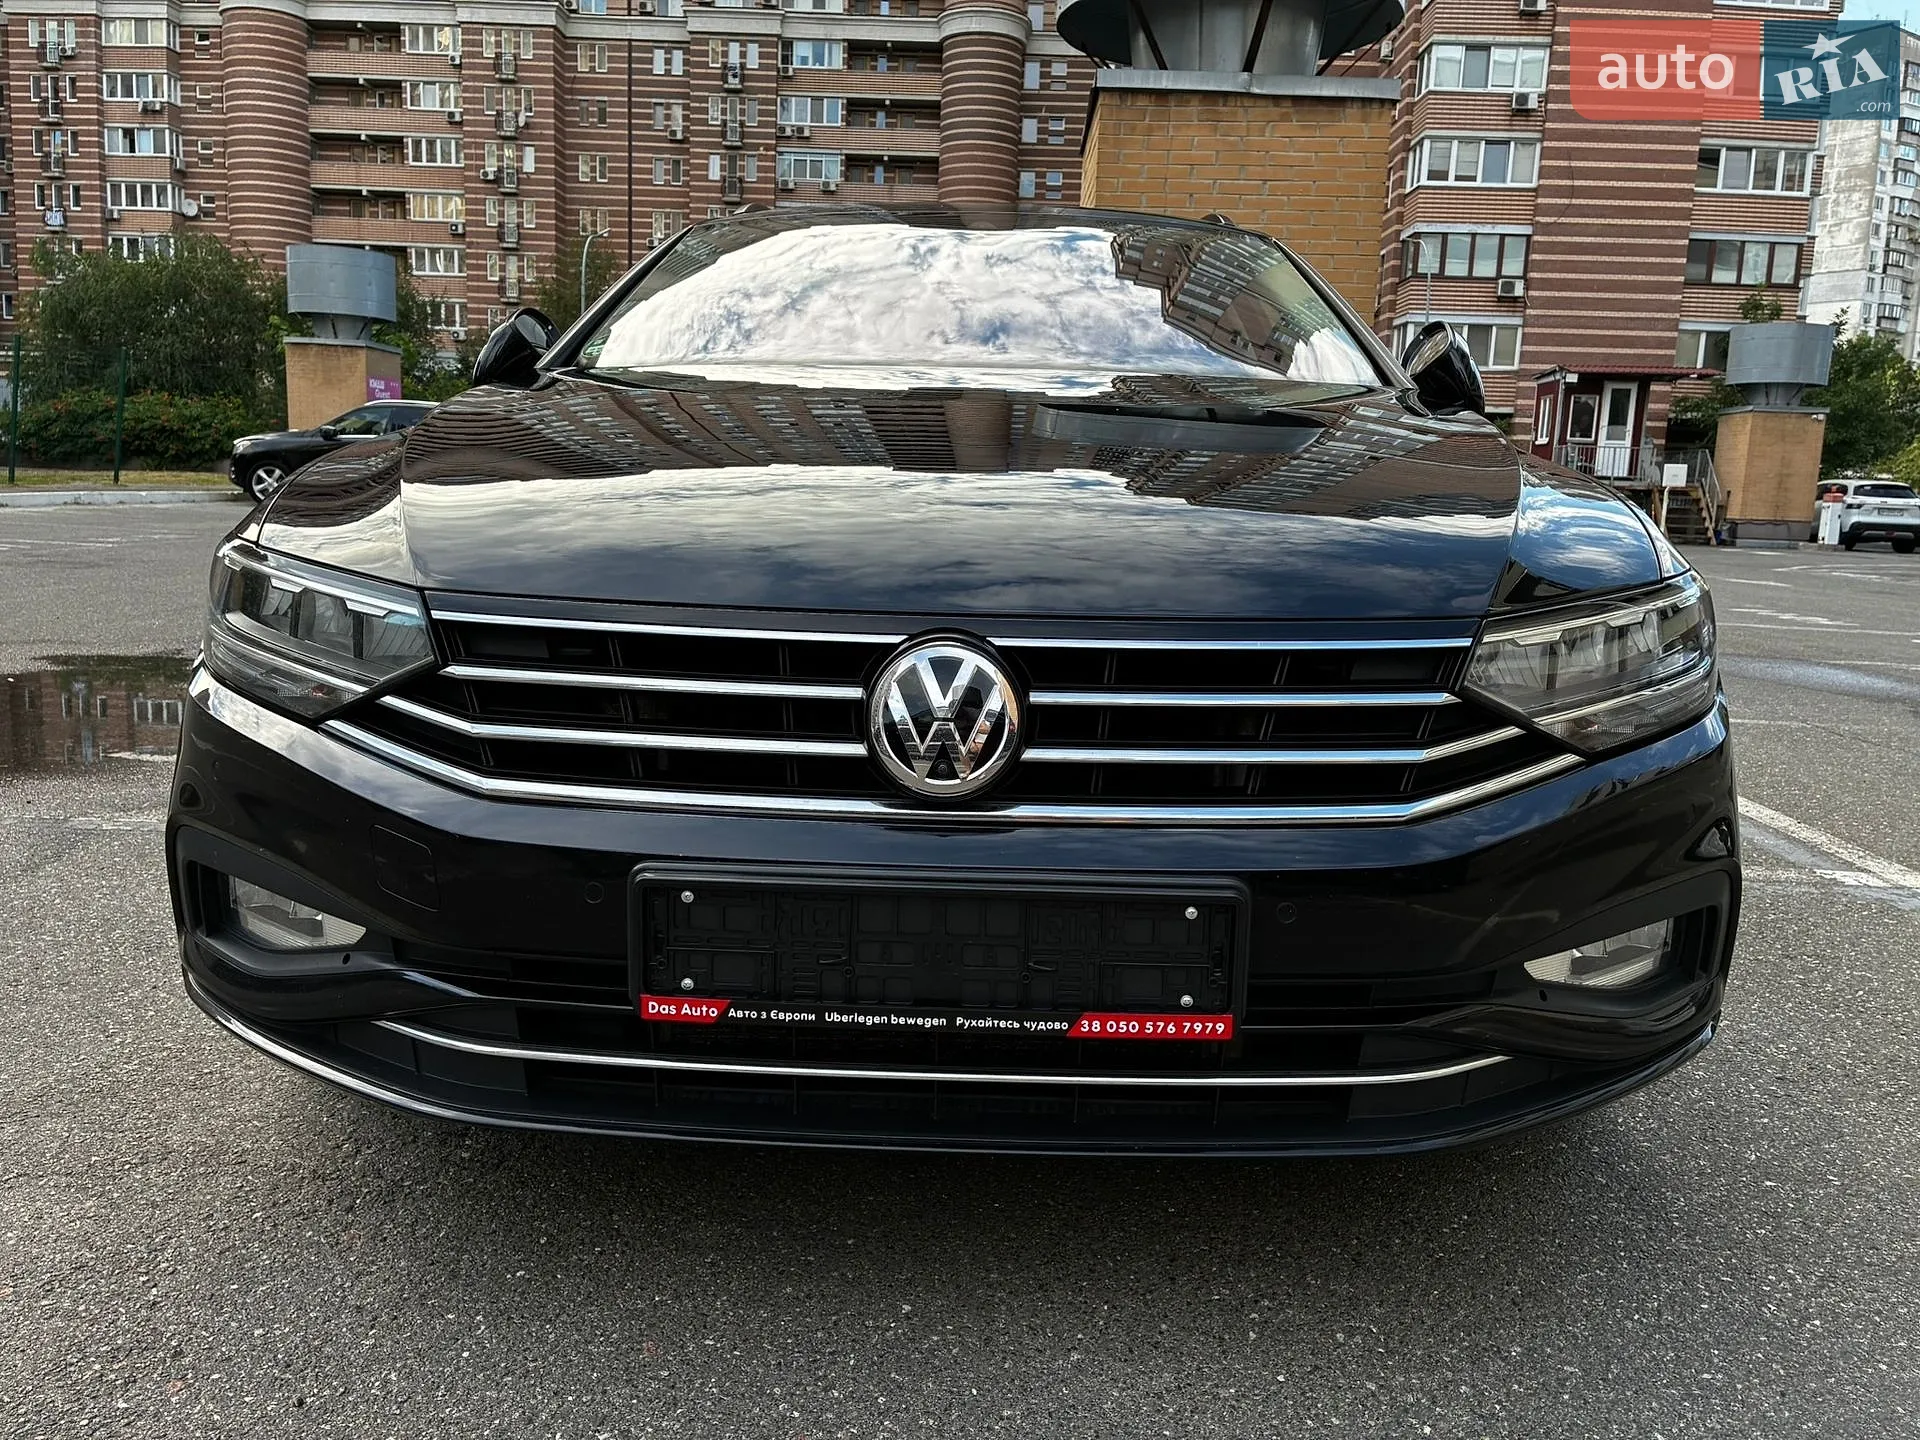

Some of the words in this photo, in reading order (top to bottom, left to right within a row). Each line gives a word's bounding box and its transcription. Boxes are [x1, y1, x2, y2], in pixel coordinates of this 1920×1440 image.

[648, 1001, 677, 1015] Das
[680, 1003, 718, 1017] Auto
[727, 1007, 758, 1019] Авто
[770, 1009, 816, 1023] Європи
[824, 1011, 888, 1026] Uberlegen
[890, 1013, 947, 1028] bewegen
[956, 1016, 1021, 1030] Рухайтесь
[1023, 1020, 1069, 1032] чудово
[1080, 1019, 1101, 1033] 38
[1106, 1020, 1140, 1034] 050
[1144, 1021, 1176, 1034] 576
[1182, 1021, 1225, 1035] 7979
